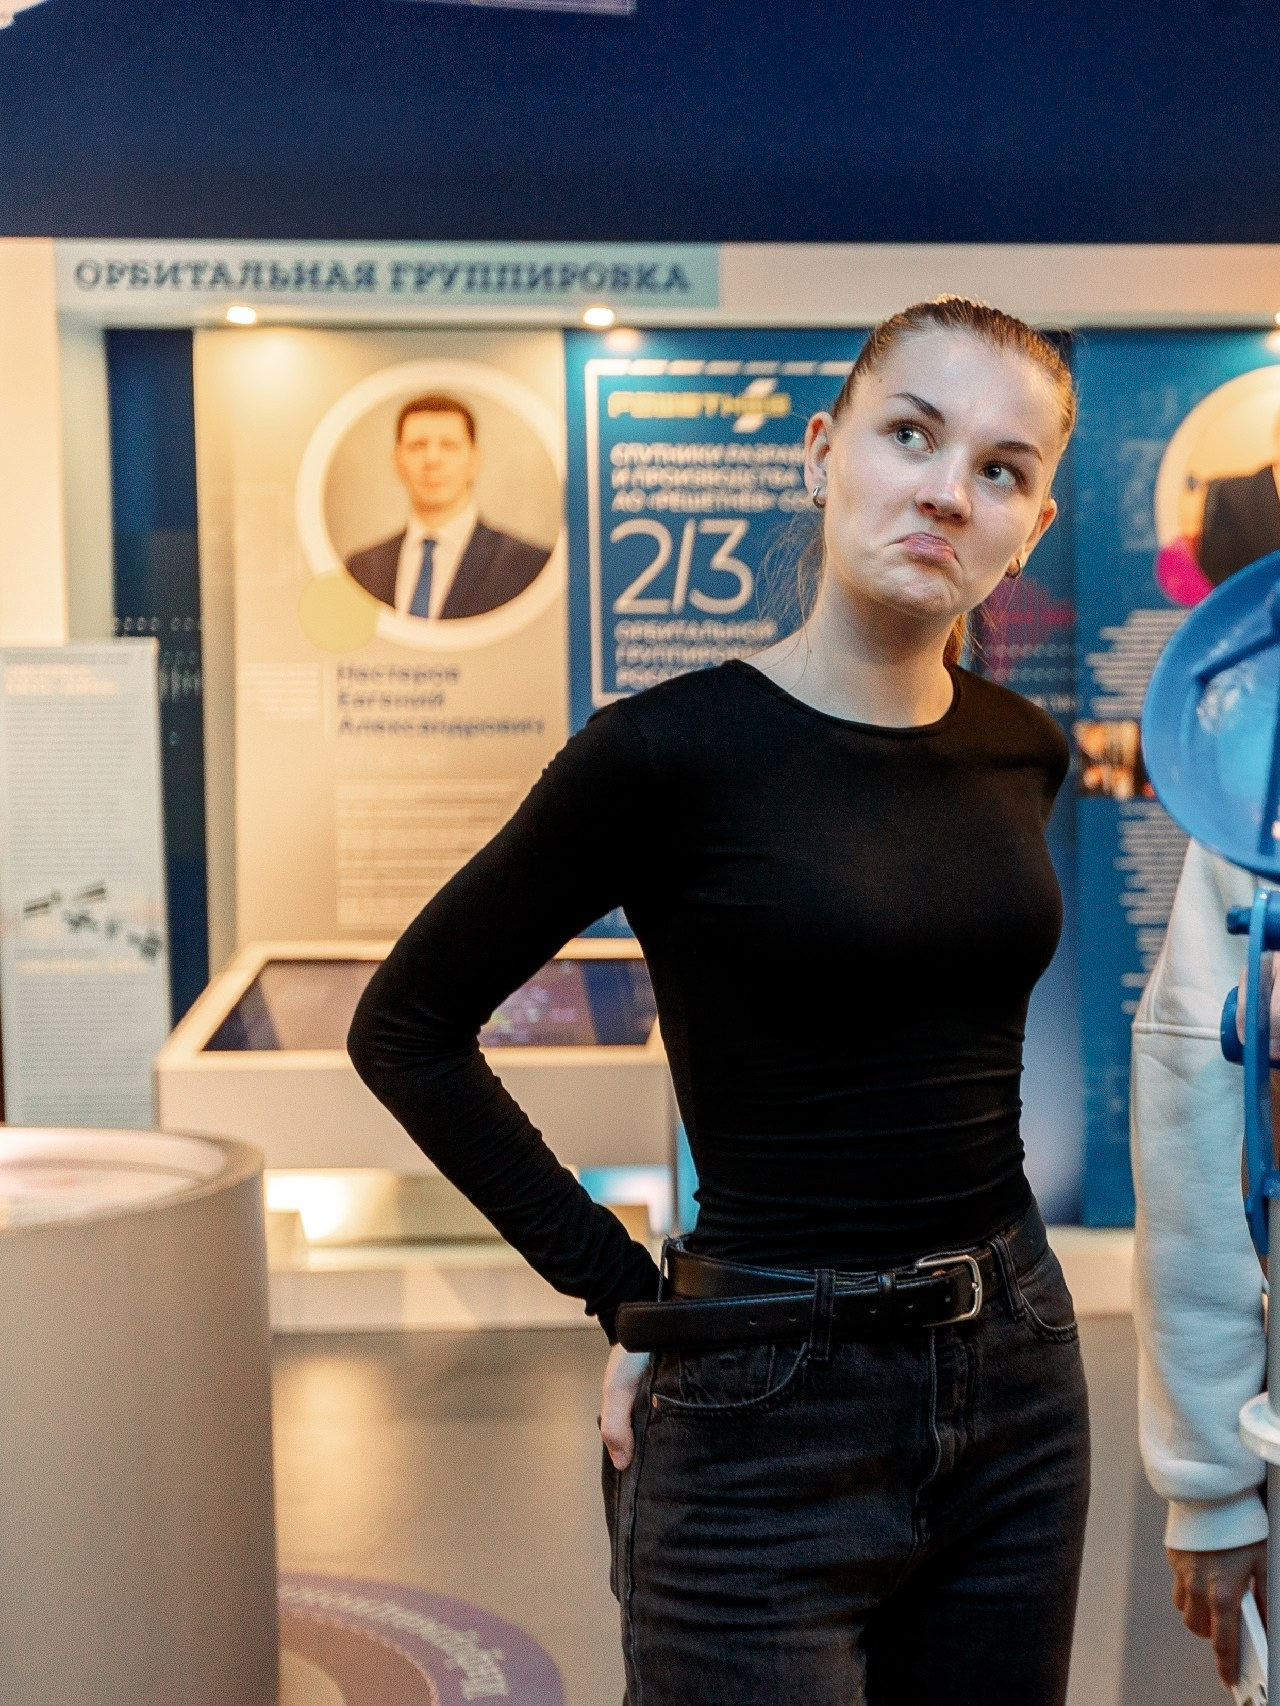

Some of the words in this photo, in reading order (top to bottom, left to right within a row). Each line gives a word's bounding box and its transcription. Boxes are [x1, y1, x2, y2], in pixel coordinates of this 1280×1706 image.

[74, 258, 377, 291] ОРБИТАЛЬНАЯ
[390, 260, 690, 293] ГРУППИРОВКА
[611, 443, 724, 465] СПУТНИКИ
[612, 467, 631, 488] И
[612, 489, 646, 511] АО
[610, 518, 754, 614] 2/3
[615, 620, 777, 642] ОРБИТАЛЬНОЙ
